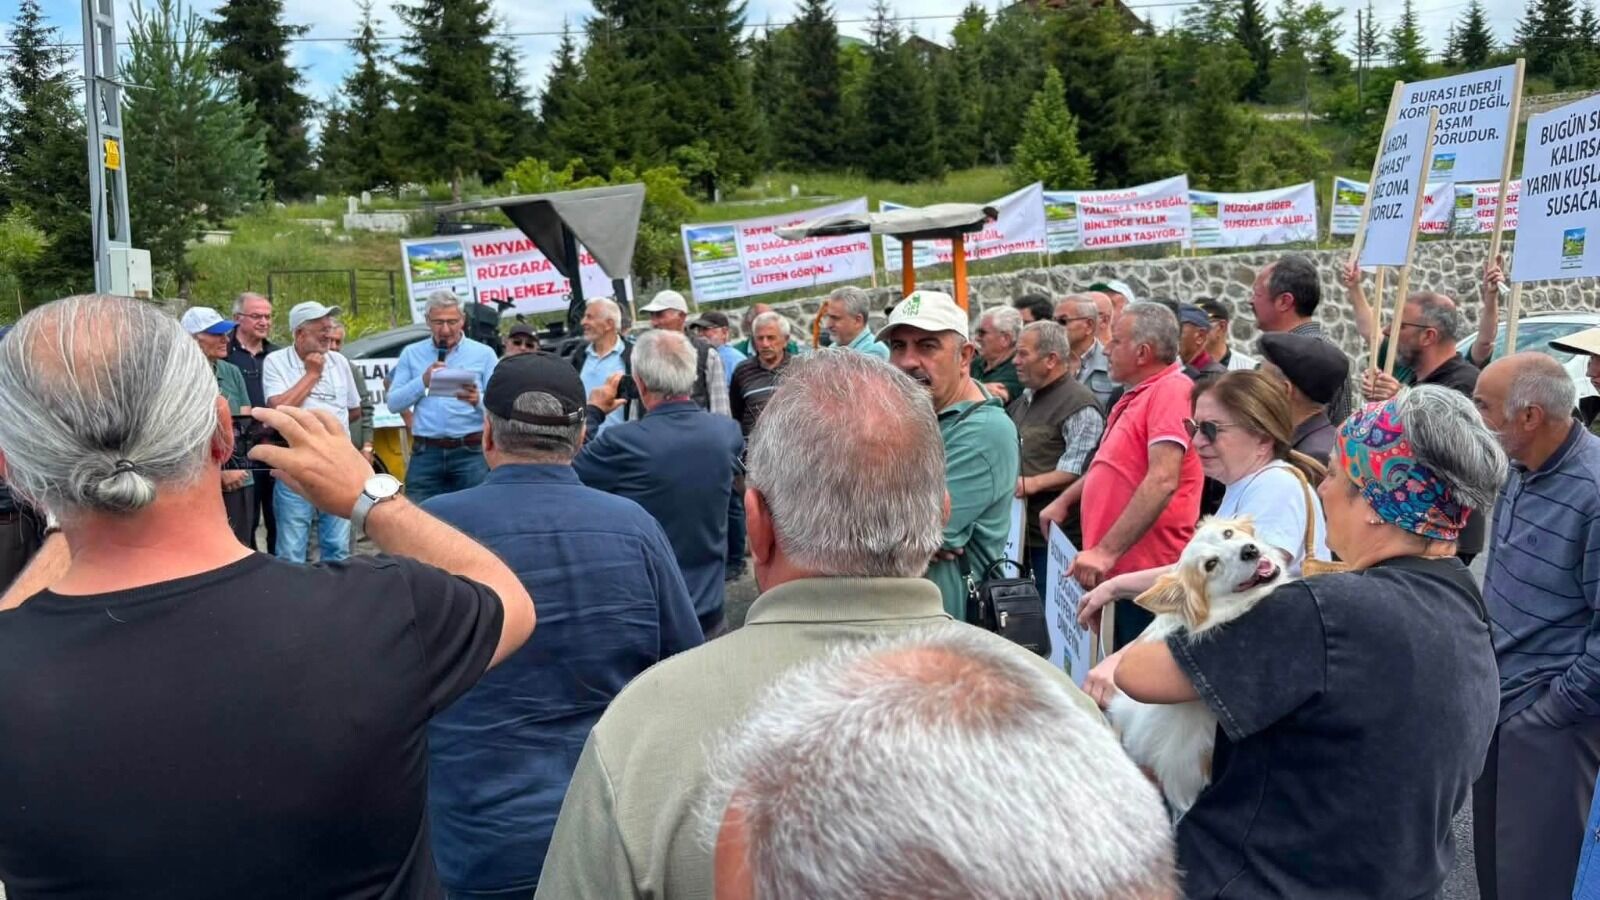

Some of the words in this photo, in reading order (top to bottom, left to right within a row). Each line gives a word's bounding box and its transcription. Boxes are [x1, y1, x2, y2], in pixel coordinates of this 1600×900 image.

[1410, 87, 1457, 104] BURASI
[1459, 76, 1502, 97] ENERJİ
[1469, 92, 1510, 111] DEĞİL,
[1435, 115, 1473, 132] AŞAM
[1540, 113, 1587, 145] BUGÜN
[1386, 179, 1408, 197] ONA
[1527, 171, 1561, 196] YARIN
[1563, 164, 1600, 190] KUŞL
[1083, 204, 1132, 215] YALNIZCA
[1478, 197, 1489, 206] BU
[1546, 190, 1600, 217] SUSACA
[743, 225, 772, 237] SAYIN
[1084, 218, 1133, 230] BİNLERCE
[1136, 215, 1167, 225] YILLIK
[1224, 217, 1273, 229] SUSUZLUK
[1084, 232, 1131, 246] CANLILIK
[745, 243, 759, 253] BU
[749, 259, 761, 269] DE
[763, 253, 792, 266] DOĞA
[794, 249, 813, 261] GİBİ
[816, 241, 869, 258] YÜKSEKTİR.
[477, 259, 552, 280] RÜZGARA
[751, 270, 788, 285] LÜTFEN
